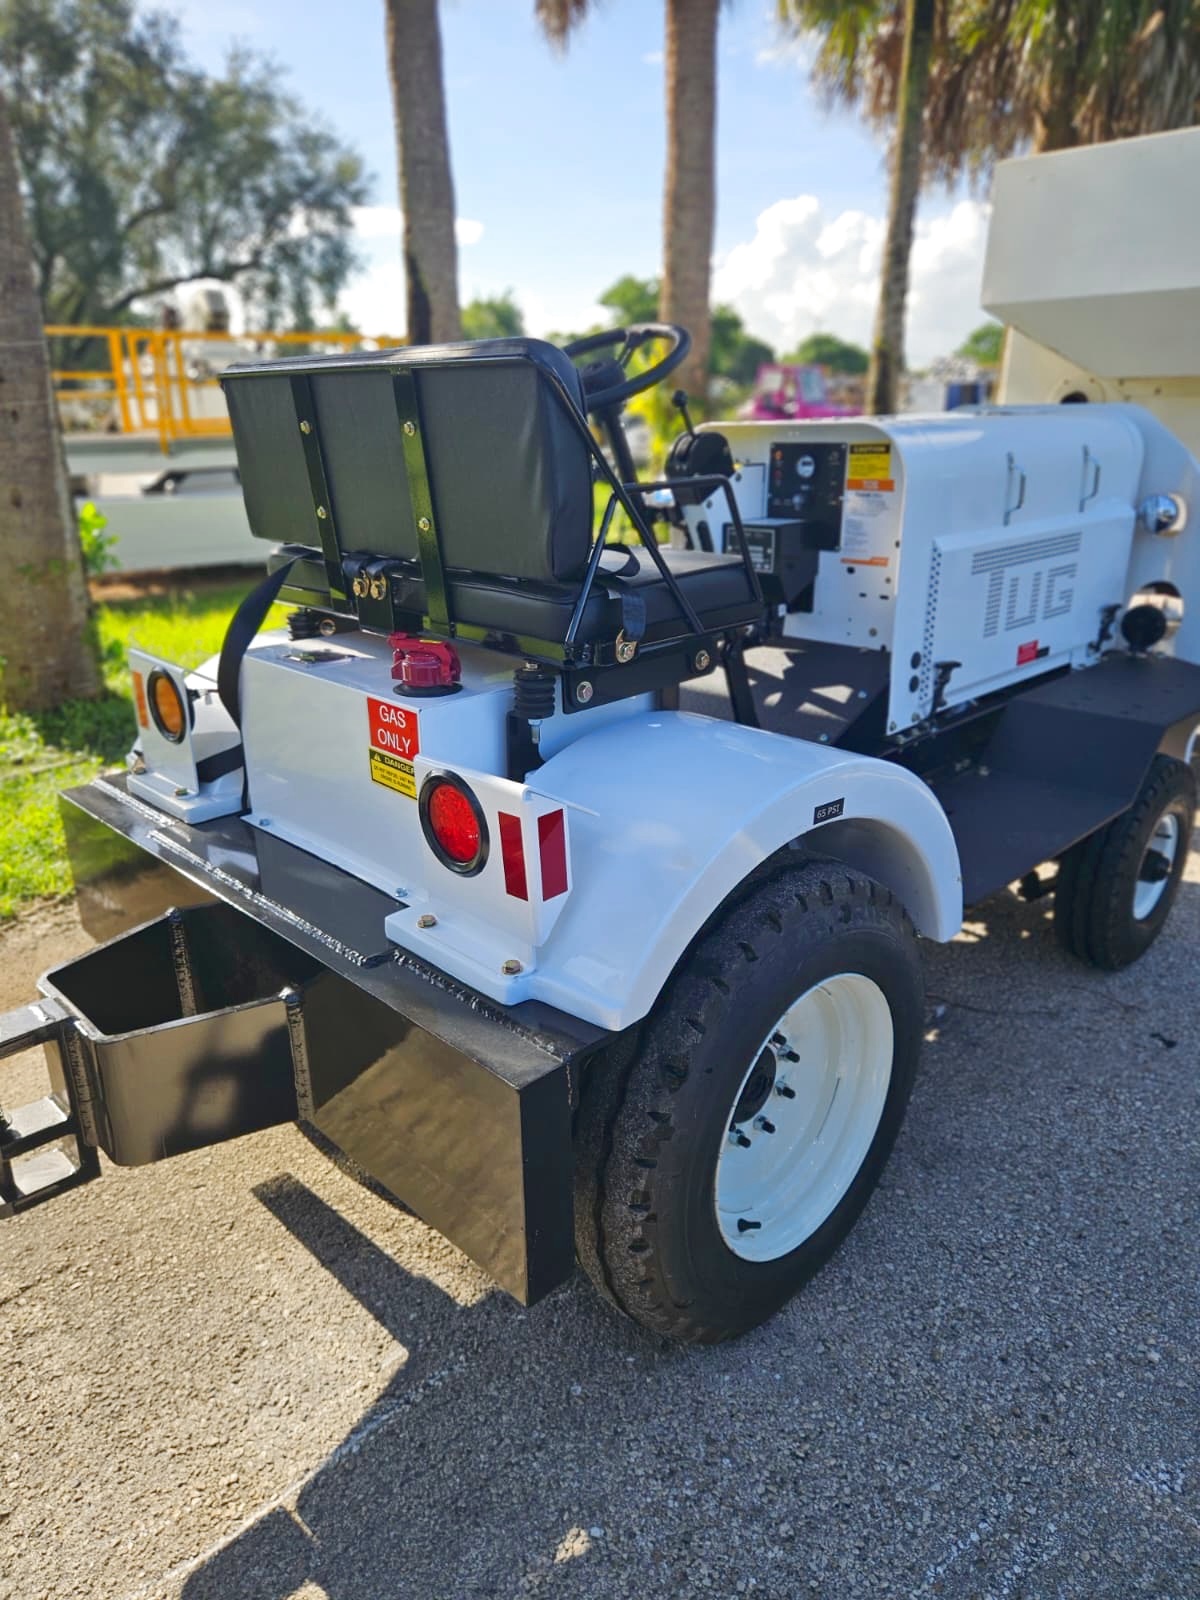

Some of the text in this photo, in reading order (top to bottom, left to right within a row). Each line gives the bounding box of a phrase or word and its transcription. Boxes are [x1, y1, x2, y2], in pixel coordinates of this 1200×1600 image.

[971, 532, 1082, 638] TUG
[379, 705, 406, 728] GAS
[377, 728, 411, 754] ONLY
[816, 804, 840, 819] 65 PSI
